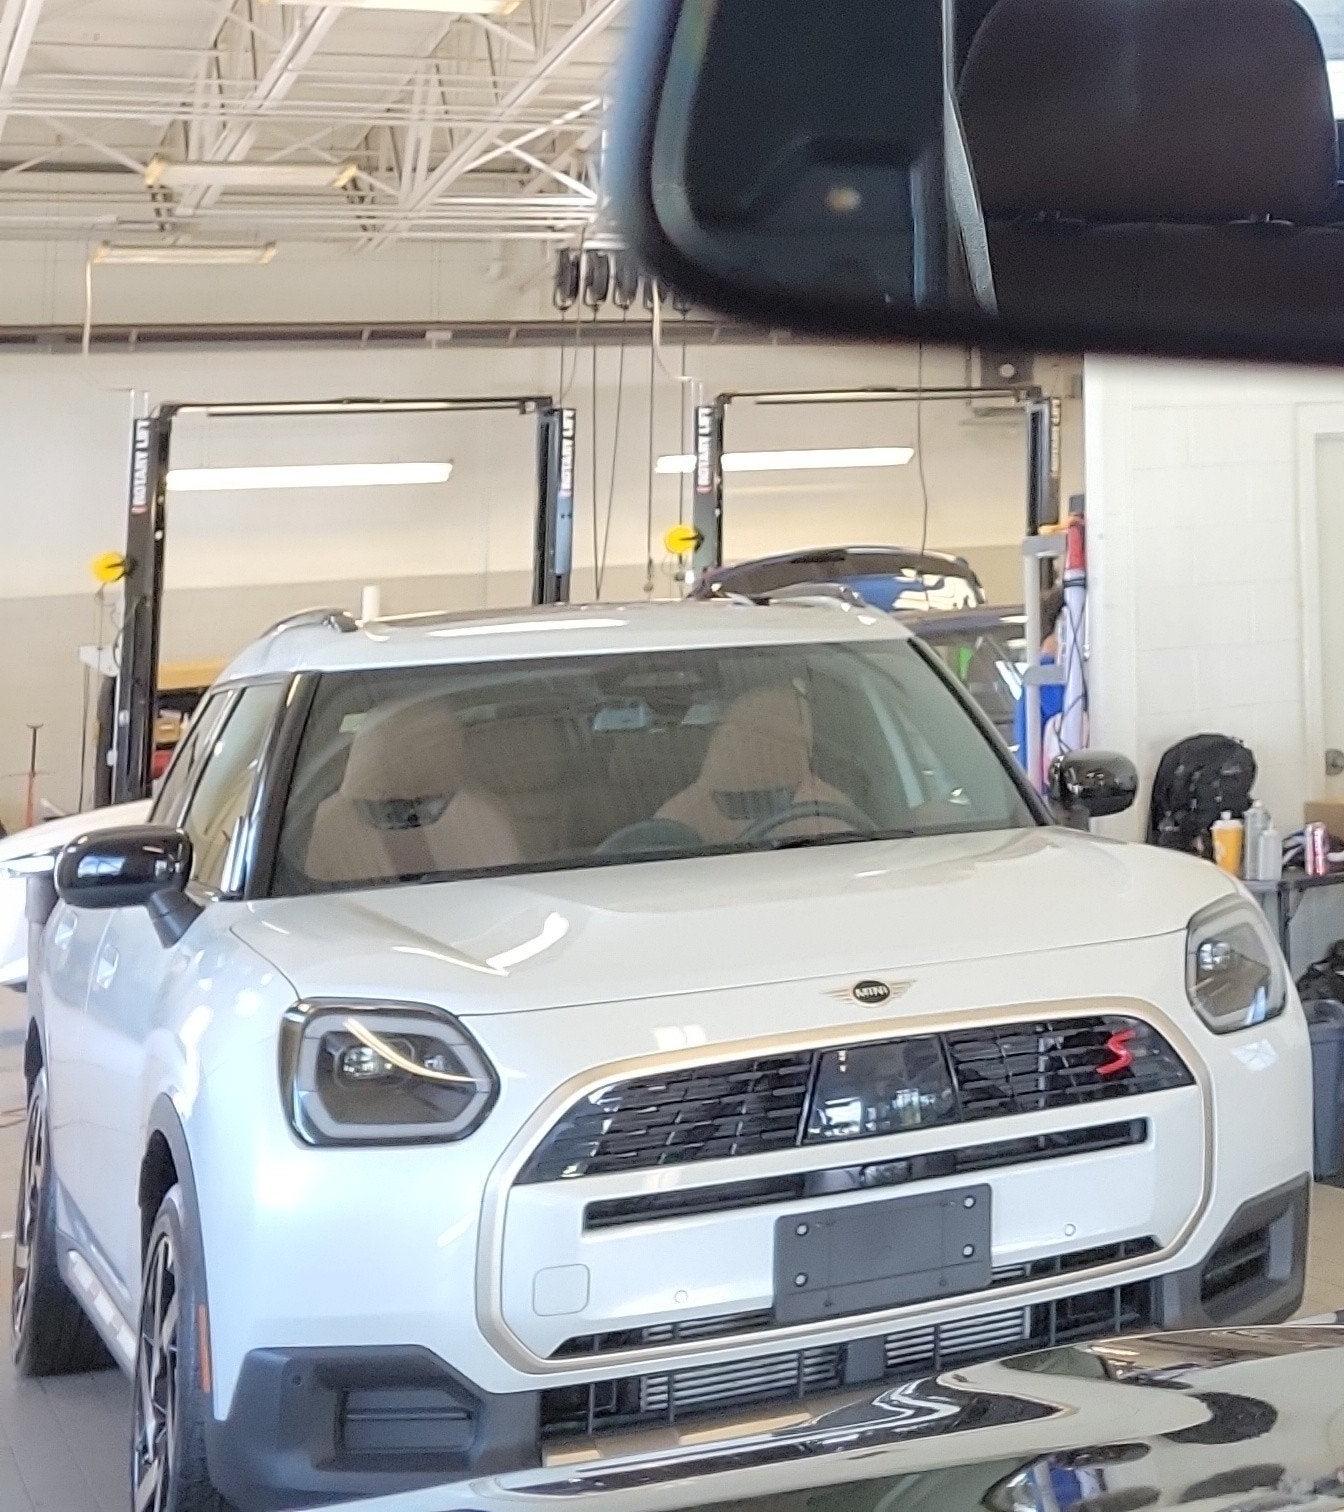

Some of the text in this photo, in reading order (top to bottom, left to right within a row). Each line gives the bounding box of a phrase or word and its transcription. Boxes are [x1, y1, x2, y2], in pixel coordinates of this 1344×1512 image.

[562, 409, 575, 437] LIFT
[698, 407, 712, 434] LIFT
[132, 420, 151, 505] ROTARY LIFT
[855, 985, 889, 999] MINI
[1096, 1029, 1136, 1074] S
